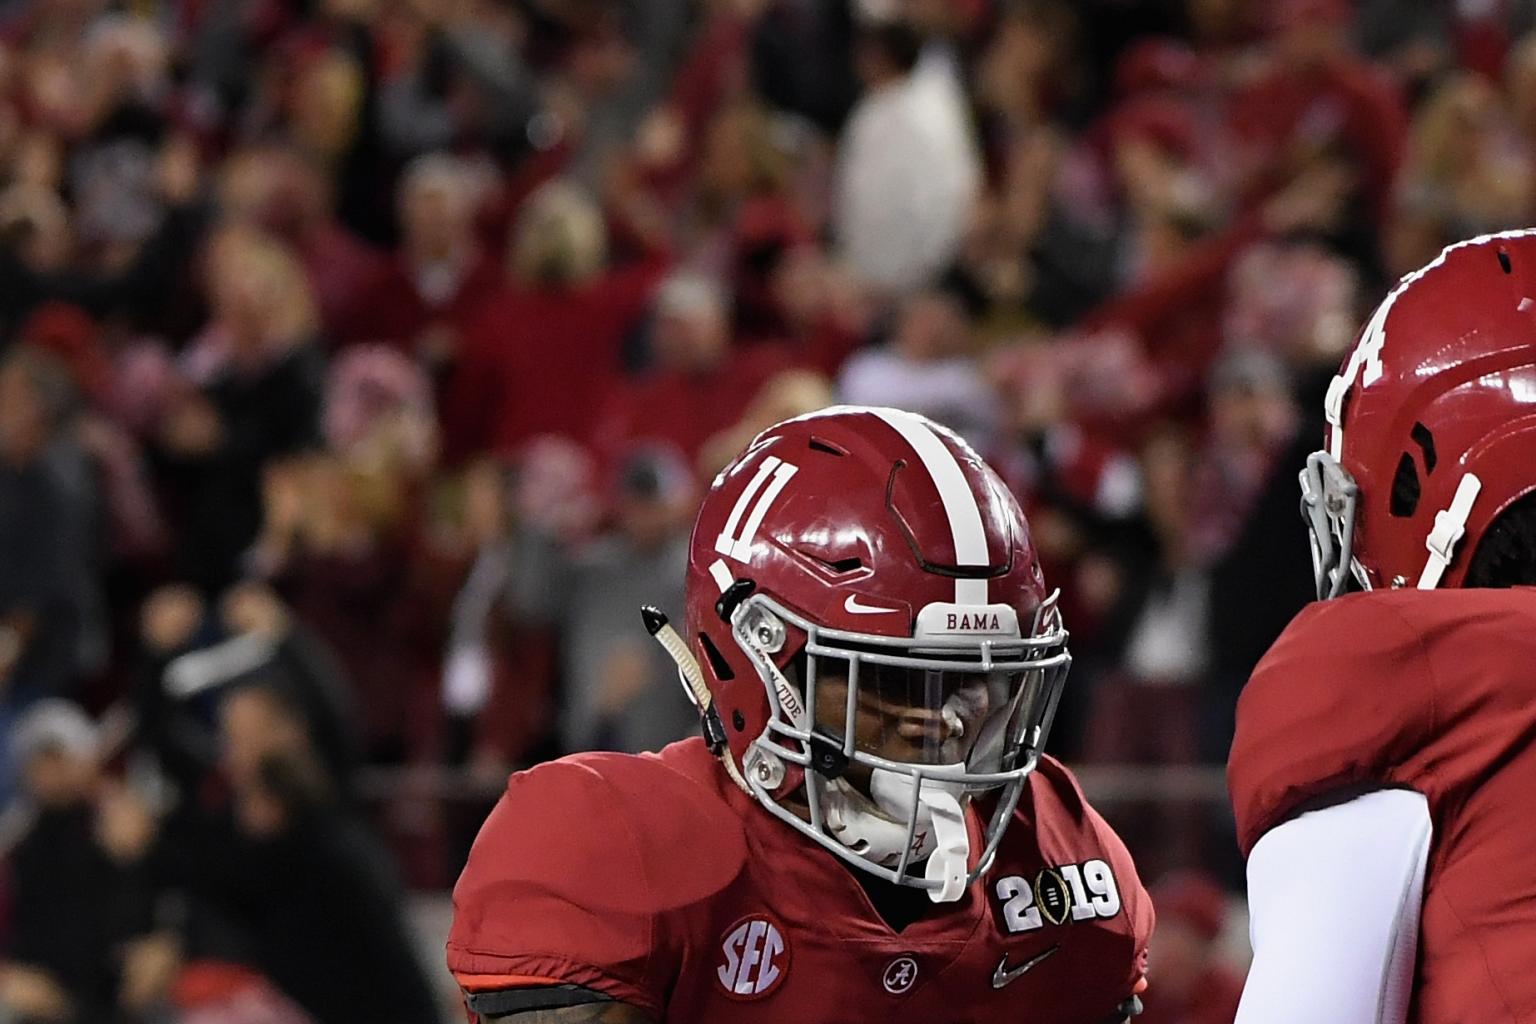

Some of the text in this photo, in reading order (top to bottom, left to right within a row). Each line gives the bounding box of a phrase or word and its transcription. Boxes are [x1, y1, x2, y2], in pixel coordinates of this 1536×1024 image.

[946, 613, 1000, 630] BAMA
[776, 684, 802, 719] TIDE
[717, 920, 784, 995] SEC
